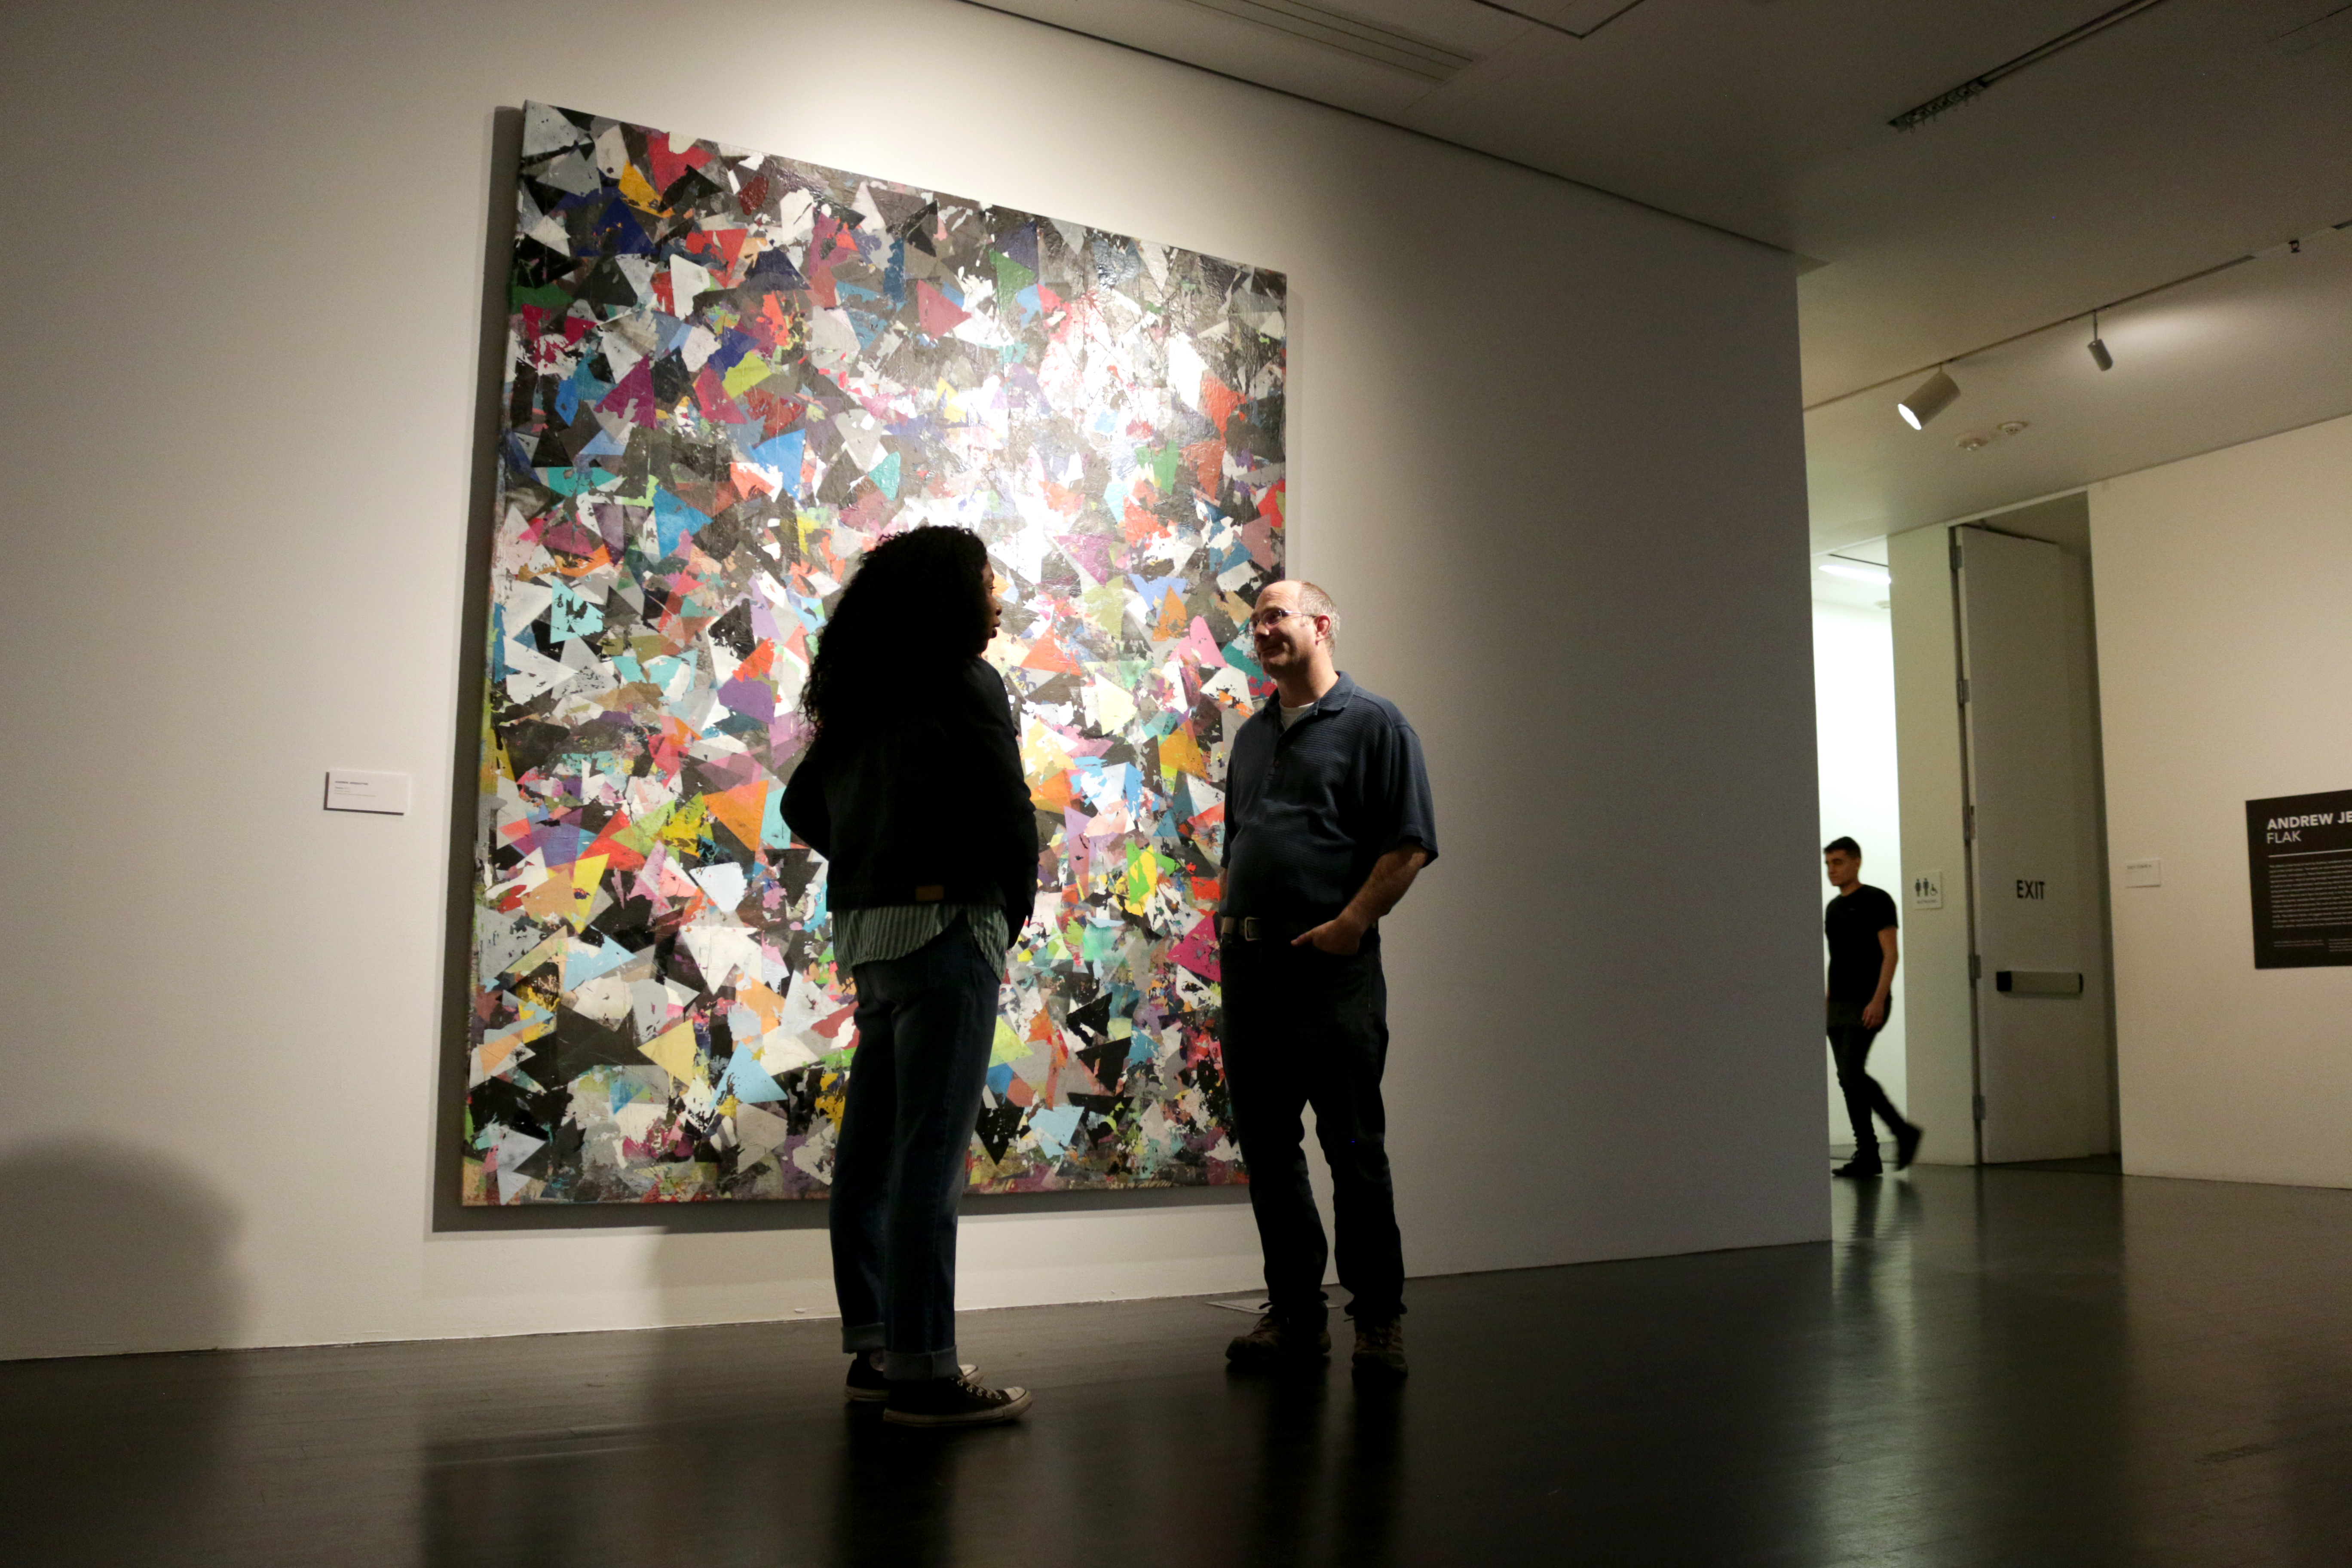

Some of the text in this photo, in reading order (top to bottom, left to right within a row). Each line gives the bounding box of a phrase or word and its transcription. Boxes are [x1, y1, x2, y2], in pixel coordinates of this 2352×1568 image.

[2267, 813, 2334, 830] ANDREW
[2266, 830, 2302, 844] FLAK
[2016, 879, 2045, 899] EXIT
